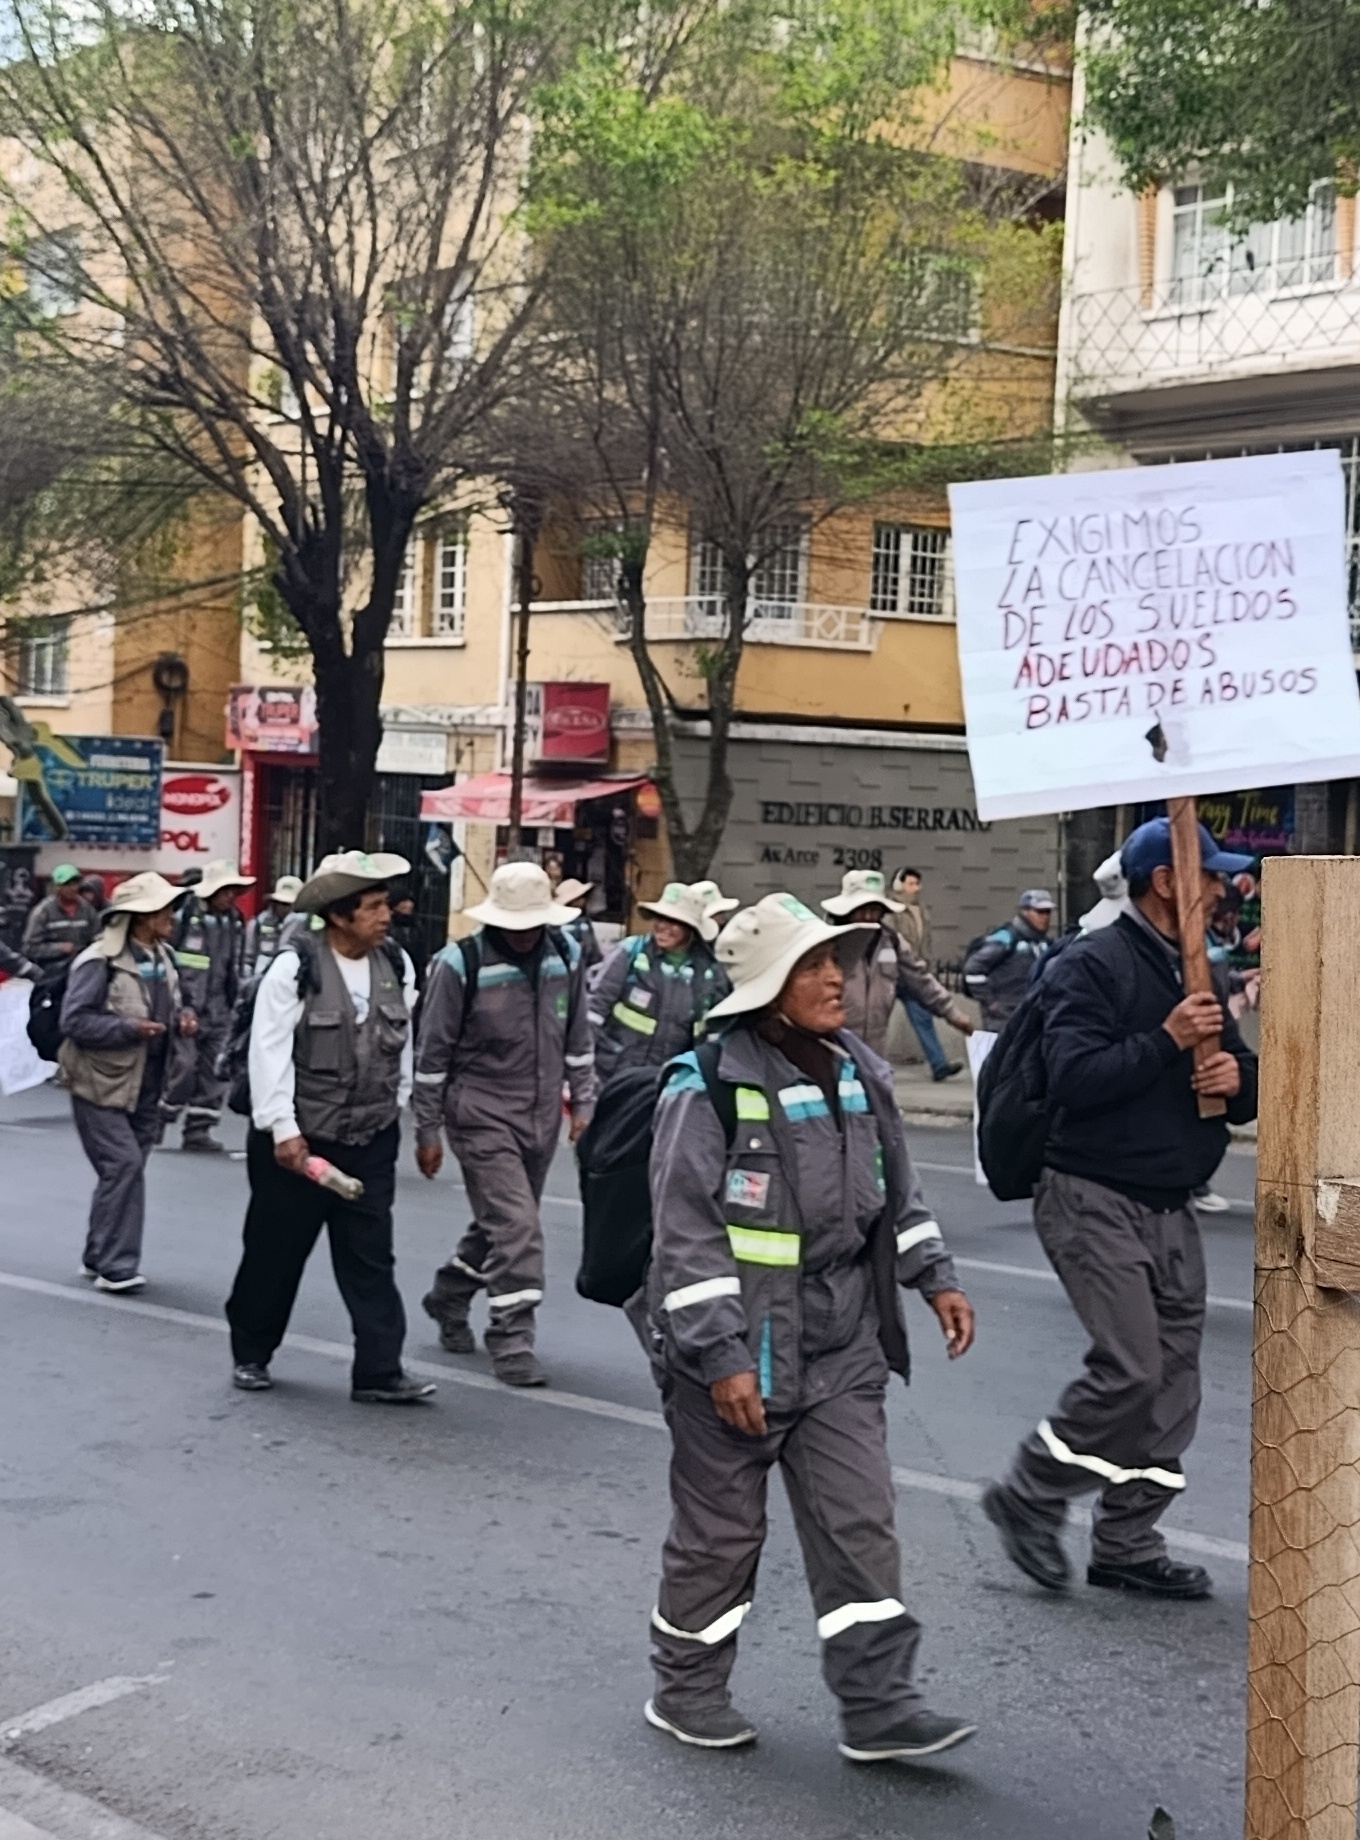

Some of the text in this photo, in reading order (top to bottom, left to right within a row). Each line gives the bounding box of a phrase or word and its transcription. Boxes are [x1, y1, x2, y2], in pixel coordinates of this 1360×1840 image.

[1008, 506, 1201, 565] EXIGIMOS
[997, 538, 1295, 608] LA CANCELACION
[1003, 588, 1297, 650] DE LOS SUELDOS
[1013, 632, 1216, 689] ADEUDADOS
[1026, 667, 1317, 730] BASTA DE ABUSOS
[77, 771, 153, 790] TRUPER
[760, 800, 862, 828] EDIFICIO
[833, 847, 883, 871] 2308
